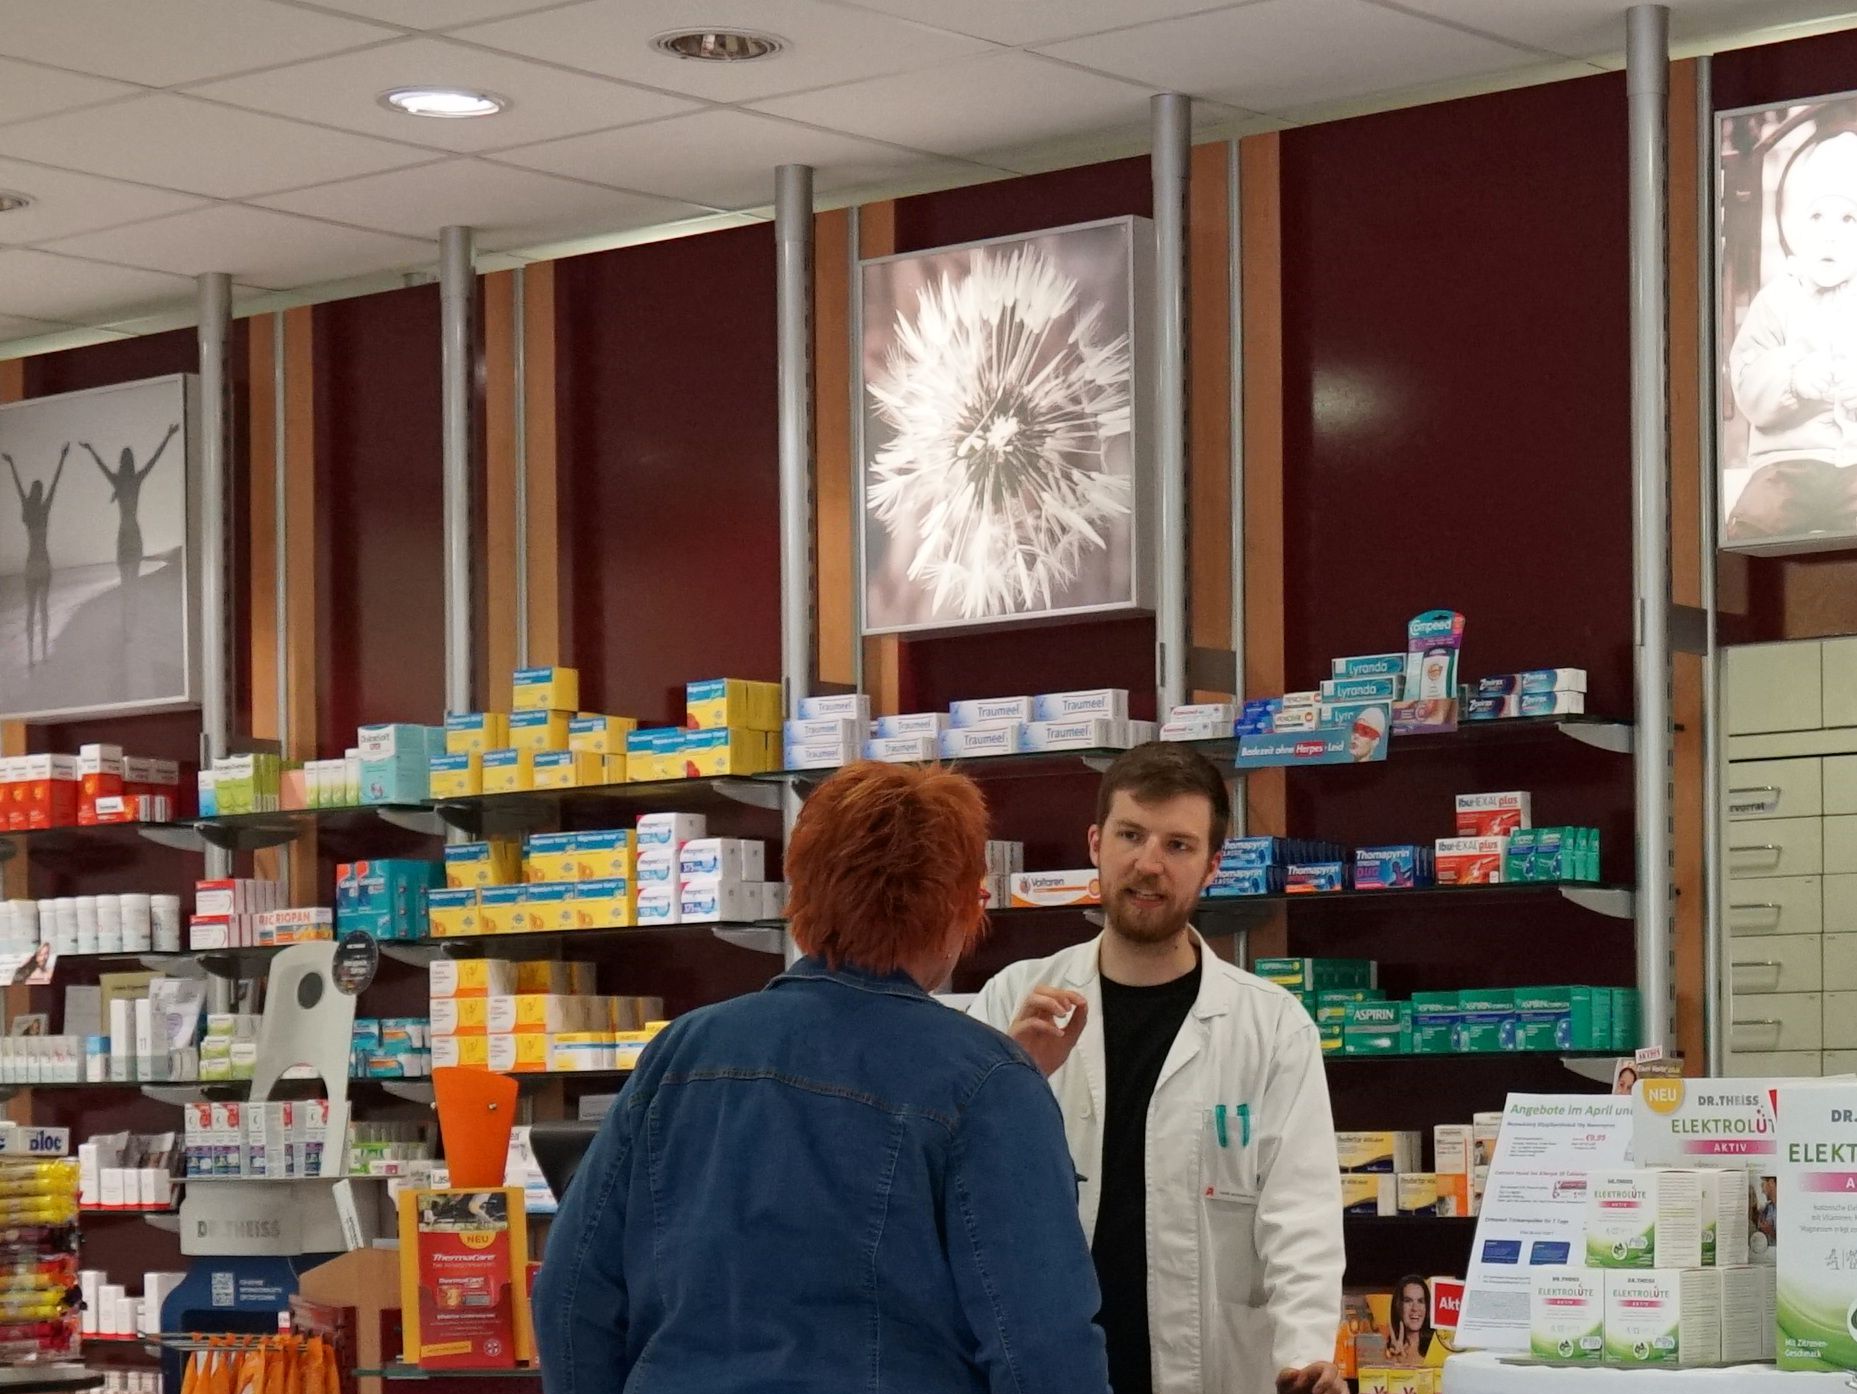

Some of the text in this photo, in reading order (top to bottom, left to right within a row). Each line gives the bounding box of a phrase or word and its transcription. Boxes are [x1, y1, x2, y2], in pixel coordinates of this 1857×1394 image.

[1409, 619, 1452, 635] Compeed
[1349, 661, 1388, 675] Lyranda
[1337, 684, 1377, 698] Lyranda
[818, 701, 853, 711] Traumeel
[1063, 697, 1106, 711] Traumeel
[978, 704, 1020, 717] Traumeel
[804, 725, 838, 734] Traumeel
[897, 721, 931, 730] Traumeel
[1046, 726, 1089, 739] Traumeel
[964, 732, 1006, 745] Traumeel
[885, 743, 918, 752] Traumeel
[1241, 747, 1274, 757] Badezeit
[1275, 746, 1295, 755] ohne
[1296, 743, 1323, 755] Herpes
[805, 749, 839, 758] Traumeel
[1498, 797, 1518, 808] plus
[1222, 841, 1269, 851] homapyrin
[1478, 839, 1498, 852] plus
[1355, 850, 1409, 860] Thomapyrin
[1214, 869, 1263, 879] homapyrin
[1287, 865, 1339, 876] Thomapyrin
[1031, 877, 1065, 887] Voltaren
[276, 912, 311, 923] RIOPAN
[1353, 1008, 1394, 1020] ASPIRIN
[1648, 1088, 1677, 1102] NEU
[1510, 1104, 1565, 1117] Angebote
[1568, 1104, 1582, 1114] im
[1585, 1104, 1613, 1116] April
[1713, 1143, 1748, 1153] AKTIV
[1789, 1143, 1857, 1163] ELEKT
[466, 1235, 489, 1243] NEU
[432, 1254, 496, 1262] ThermaCare
